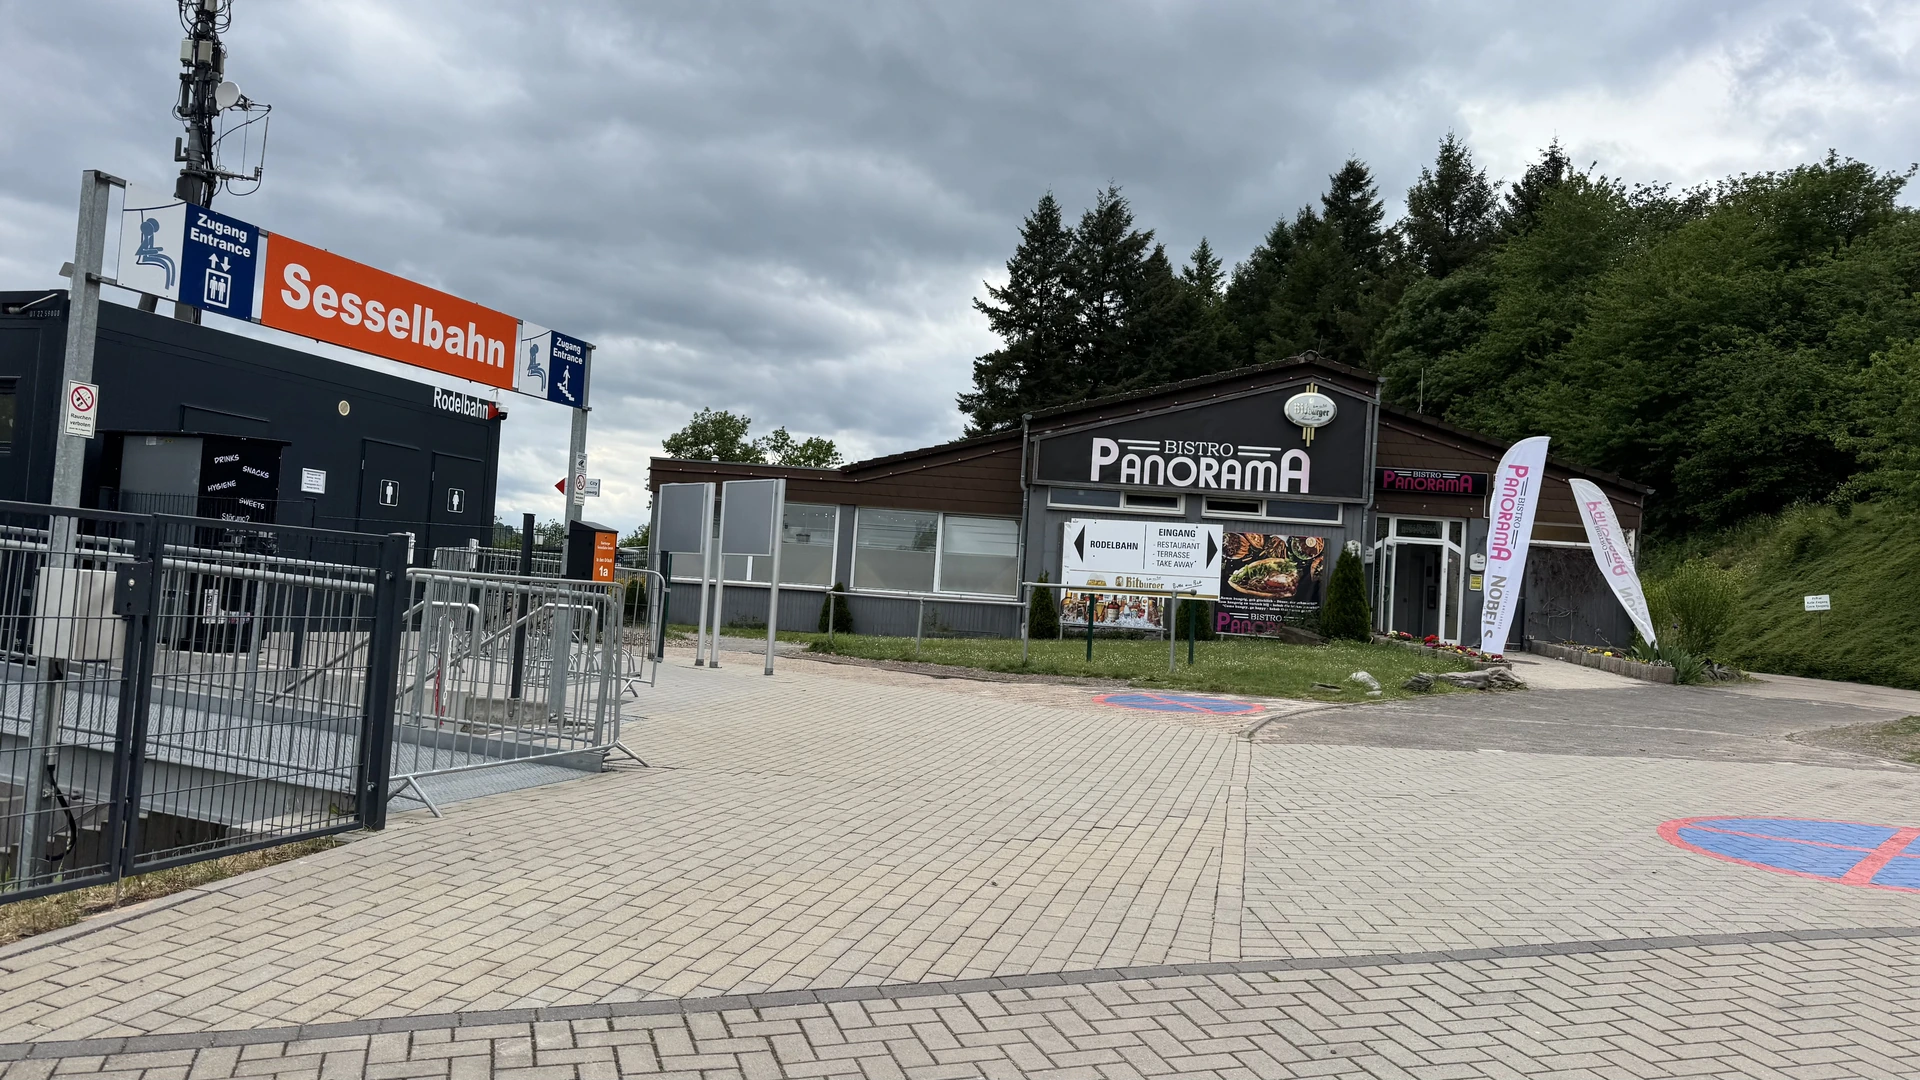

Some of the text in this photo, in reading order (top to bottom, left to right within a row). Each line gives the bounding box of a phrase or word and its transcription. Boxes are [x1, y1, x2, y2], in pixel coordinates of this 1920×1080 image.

[197, 213, 247, 243] Zugang
[190, 227, 251, 257] Entrance
[281, 263, 505, 368] Sesselbahn
[556, 337, 581, 354] Zugang
[553, 348, 583, 365] Entrance
[433, 386, 489, 420] Rodelbahn
[1164, 440, 1234, 457] BISTRO
[214, 454, 240, 464] DRINKS
[1090, 437, 1311, 494] PANORAMA
[242, 465, 270, 479] SNACKS
[1413, 471, 1442, 479] BISTRO
[207, 480, 237, 492] HYGIENE
[1383, 470, 1473, 493] PANORAMA
[239, 497, 265, 510] SWEETS
[1490, 464, 1530, 562] PANORAMA
[1513, 497, 1526, 529] BISTRO
[1158, 528, 1196, 538] EINGANG
[1090, 540, 1139, 551] RODELBAHN
[1157, 541, 1201, 550] RESTAURANT
[1157, 550, 1190, 559] TERRASSE
[1173, 560, 1194, 568] AWAY
[599, 565, 609, 577] 1a
[1125, 576, 1165, 589] Bitburger
[1250, 613, 1283, 622] BISTRO
